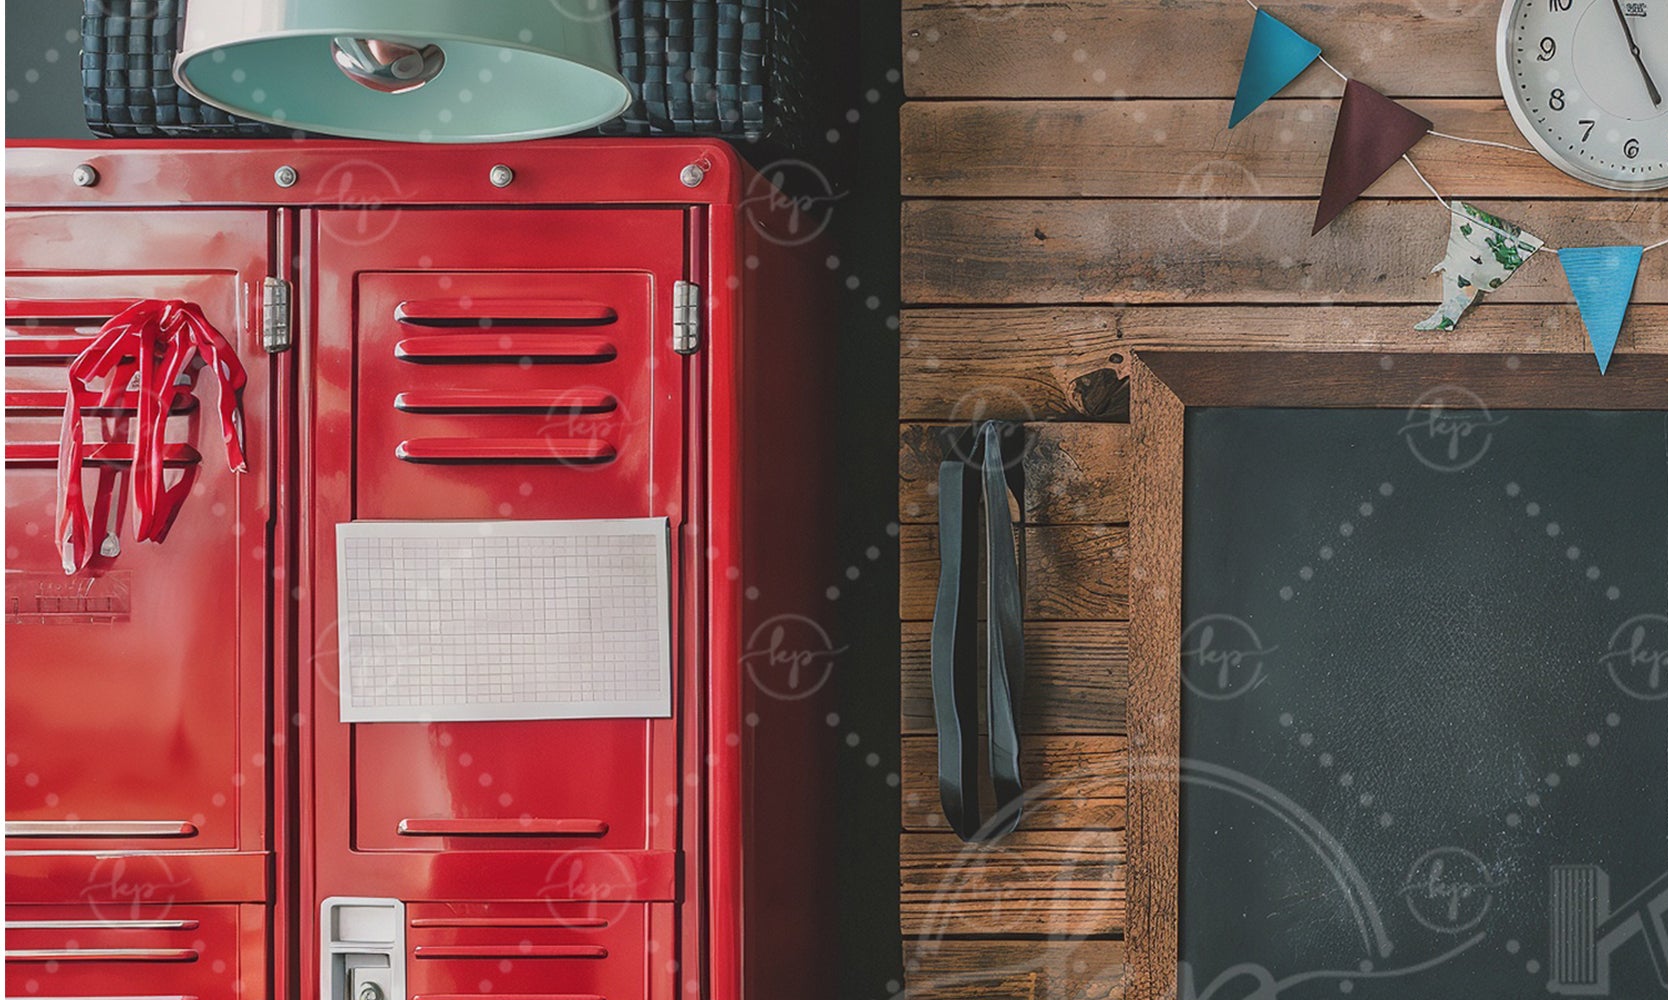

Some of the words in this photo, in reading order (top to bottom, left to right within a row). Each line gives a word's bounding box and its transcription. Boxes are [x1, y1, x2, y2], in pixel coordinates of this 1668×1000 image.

[1536, 36, 1557, 61] 9
[1549, 88, 1565, 111] 8
[1578, 120, 1595, 142] 7
[1623, 138, 1640, 159] 6
